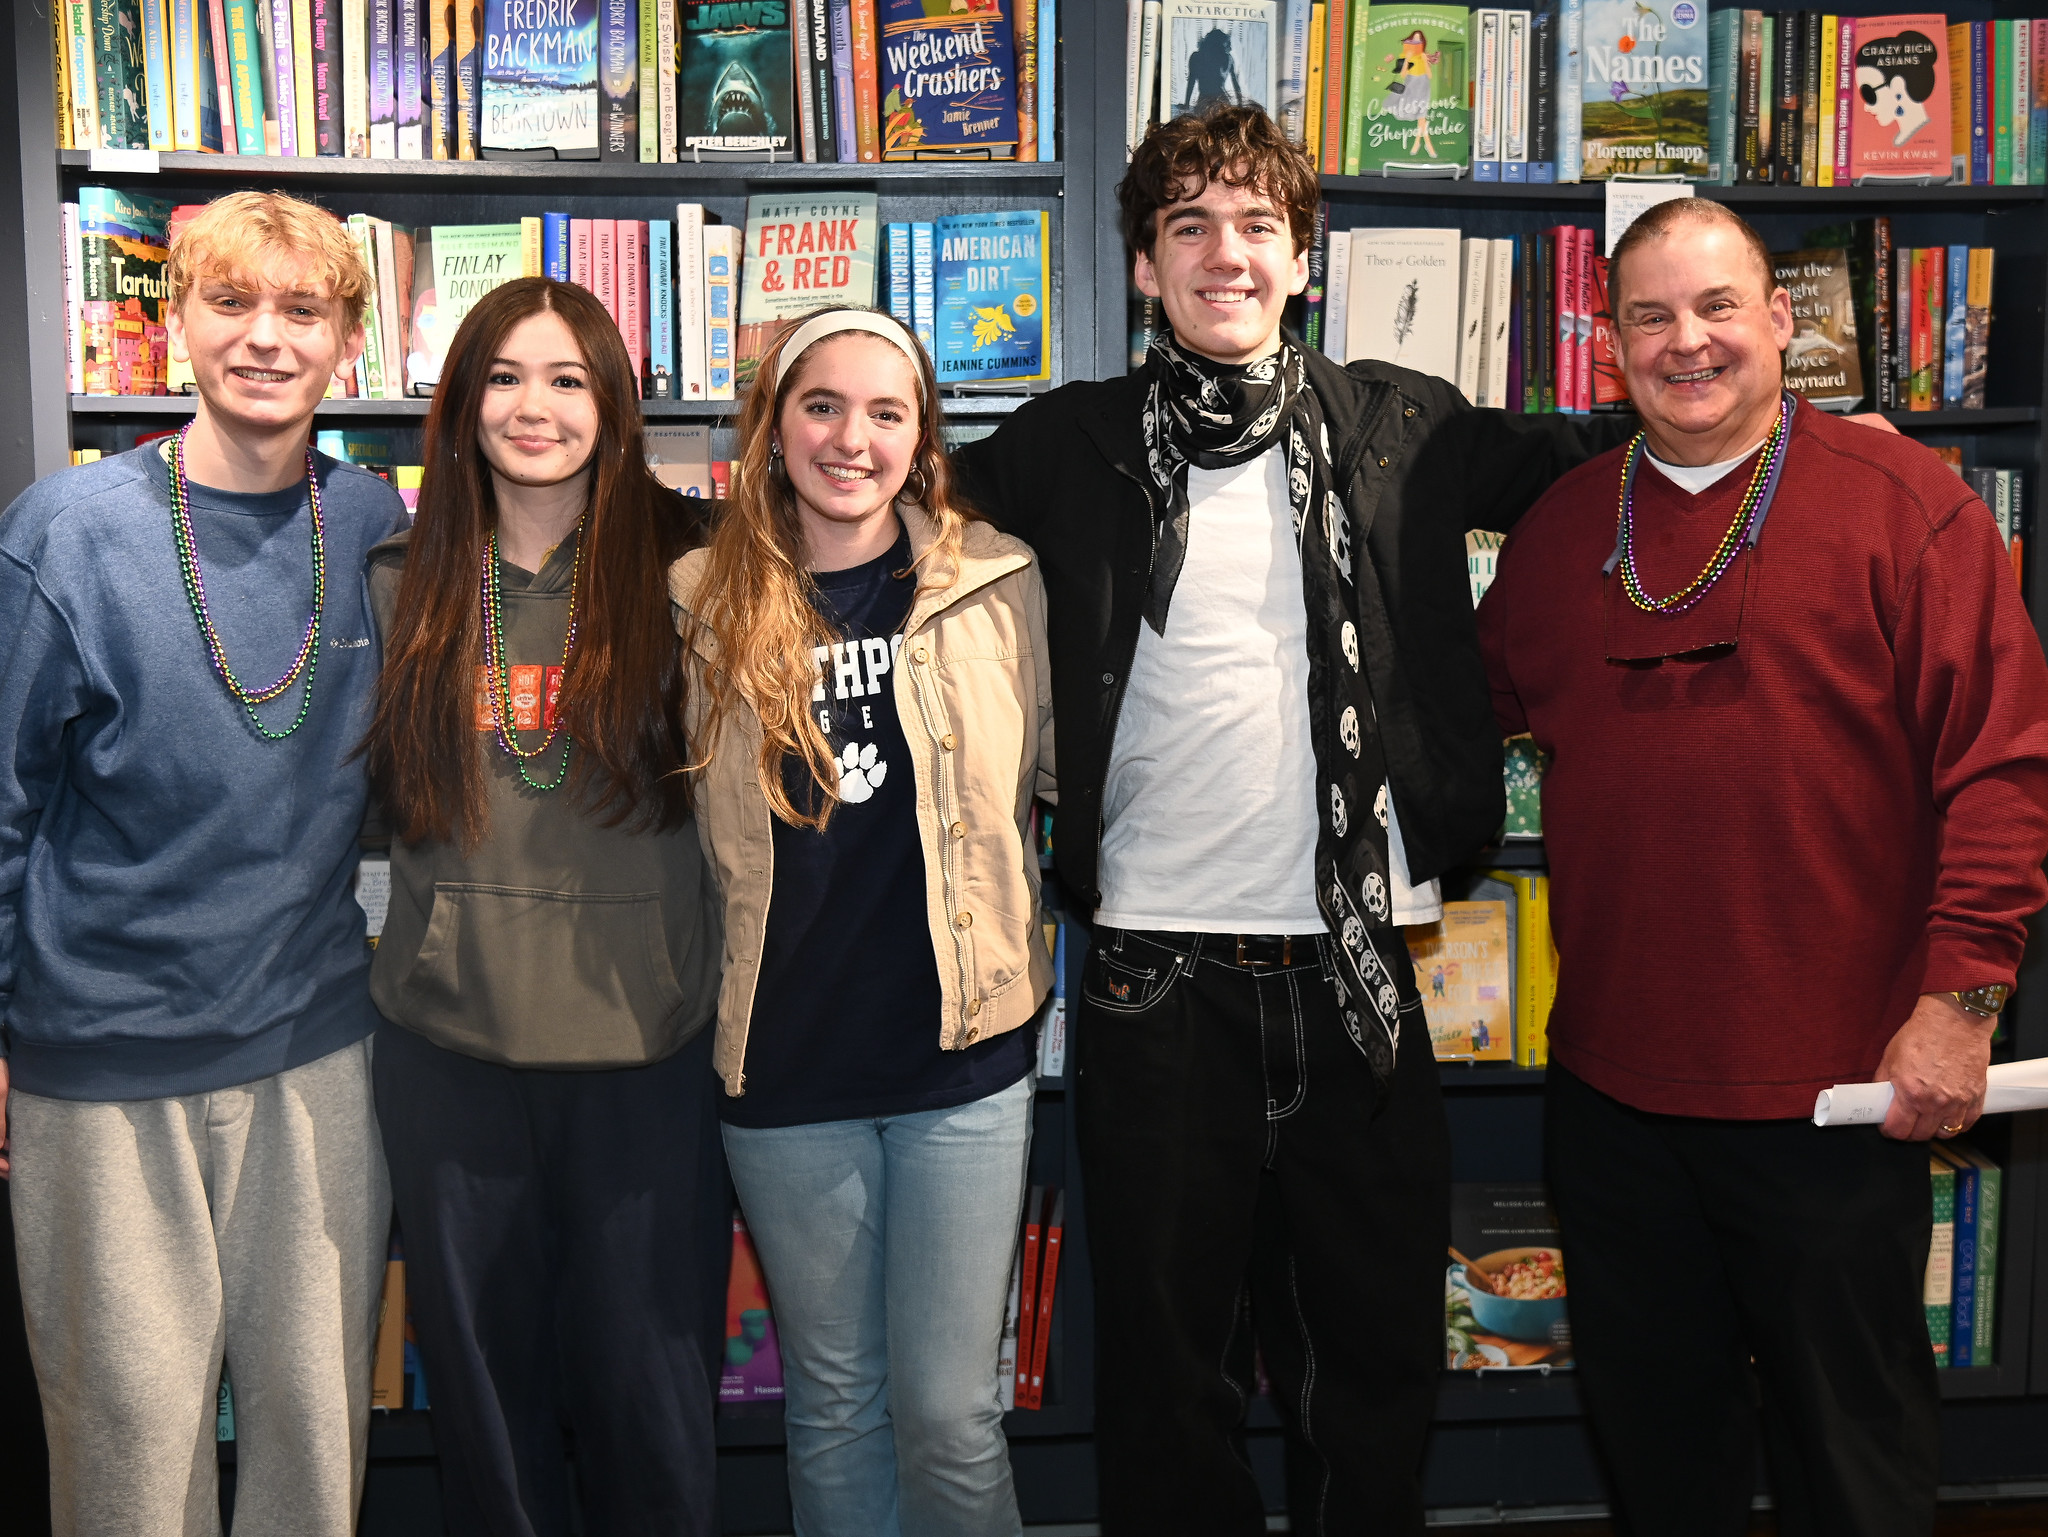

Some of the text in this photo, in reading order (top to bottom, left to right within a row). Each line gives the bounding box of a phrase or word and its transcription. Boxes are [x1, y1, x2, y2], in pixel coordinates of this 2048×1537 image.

[376, 9, 389, 45] BACKMAN
[504, 0, 578, 31] FREDRIK
[686, 1, 786, 31] JAWS
[1174, 5, 1266, 19] ANTARCTICA
[1367, 19, 1409, 36] SOPHIE
[1410, 19, 1466, 36] KINSELLA
[102, 24, 115, 52] Down
[273, 11, 290, 49] Push
[314, 18, 328, 51] Bunny
[403, 12, 416, 47] BACKMAN
[644, 22, 652, 64] BACKMAN
[912, 30, 928, 42] The
[1143, 16, 1153, 57] FOSTER
[1567, 12, 1579, 49] Names
[1624, 17, 1667, 42] The
[2019, 24, 2027, 57] KEVIN
[488, 30, 595, 70] BACKMAN
[608, 28, 627, 74] BACKMAN
[886, 22, 986, 75] Weekend
[1024, 21, 1036, 83] DAY READ
[1290, 19, 1303, 94] NANTUCKET RESTAURANT
[1585, 46, 1704, 83] Names
[1750, 59, 1757, 70] WE
[1783, 17, 1793, 104] THIS TENDER LAND
[1808, 13, 1818, 109] WILLIAM KENT KRUEGER
[1861, 43, 1933, 57] CRAZY RICH
[1876, 55, 1921, 67] ASIANS
[1975, 52, 1983, 74] RICH
[231, 6, 256, 129] THE HEIR APPARENT
[660, 1, 674, 146] Big Swiss Jen Beagin
[903, 61, 1002, 98] Crashers
[278, 72, 290, 106] Ashley
[317, 62, 331, 121] Mona Awad
[801, 69, 812, 111] WENDELL
[1748, 71, 1757, 114] REMEMBER
[1836, 23, 1850, 168] CREATION LAKE RACHEL KUSHNER
[491, 100, 588, 134] BEARTOWN
[941, 108, 972, 124] Jamie
[1366, 94, 1460, 122] Confessions
[609, 113, 625, 154] WINNERS
[685, 136, 788, 147] PETER BENCHLEY
[804, 112, 814, 139] BERRY
[961, 116, 1000, 137] Brenner
[1367, 116, 1466, 150] Shopaholic
[1563, 84, 1578, 172] Florence Knapp
[1586, 141, 1704, 164] Florence Knapp
[1862, 149, 1938, 161] KEVIN KWAN
[113, 198, 148, 219] Kira Jane
[761, 204, 860, 219] MATT COYNE
[559, 220, 567, 272] FINLAY DONOVAN
[578, 234, 588, 260] FINLAY
[659, 236, 668, 258] FINLAY
[687, 212, 697, 281] WENDELL BERRY
[759, 219, 860, 258] FRANK
[941, 234, 1037, 263] AMERICAN
[1336, 243, 1345, 259] the
[443, 253, 509, 276] FINLAY
[600, 233, 611, 297] FINLAY DONOVAN
[659, 258, 668, 288] DONOVAN
[761, 255, 851, 293] & RED
[890, 229, 911, 294] AMERICAN
[1308, 251, 1323, 278] Wife
[1335, 264, 1344, 287] idea
[1364, 254, 1394, 267] Theo
[1405, 254, 1447, 267] Golden
[1562, 235, 1576, 309] A Family Matter
[1579, 239, 1594, 312] A Family Matter
[1774, 262, 1834, 281] ow the
[913, 229, 935, 326] AMERICAN DIRT
[966, 265, 1012, 293] DIRT
[1778, 281, 1820, 302] ight
[626, 234, 638, 356] FINLAY DONOVAN IS KILLING IT
[659, 288, 668, 318] KNOCKS
[1814, 301, 1833, 318] In
[941, 355, 1038, 373] JEANINE CUMMINS
[1880, 325, 1891, 404] IAN McEWAN
[1918, 332, 1927, 393] James McBride
[2012, 476, 2021, 530] CELESTE NG
[518, 674, 535, 686] HOT
[551, 674, 562, 686] FI
[1960, 1239, 1975, 1272] COOK
